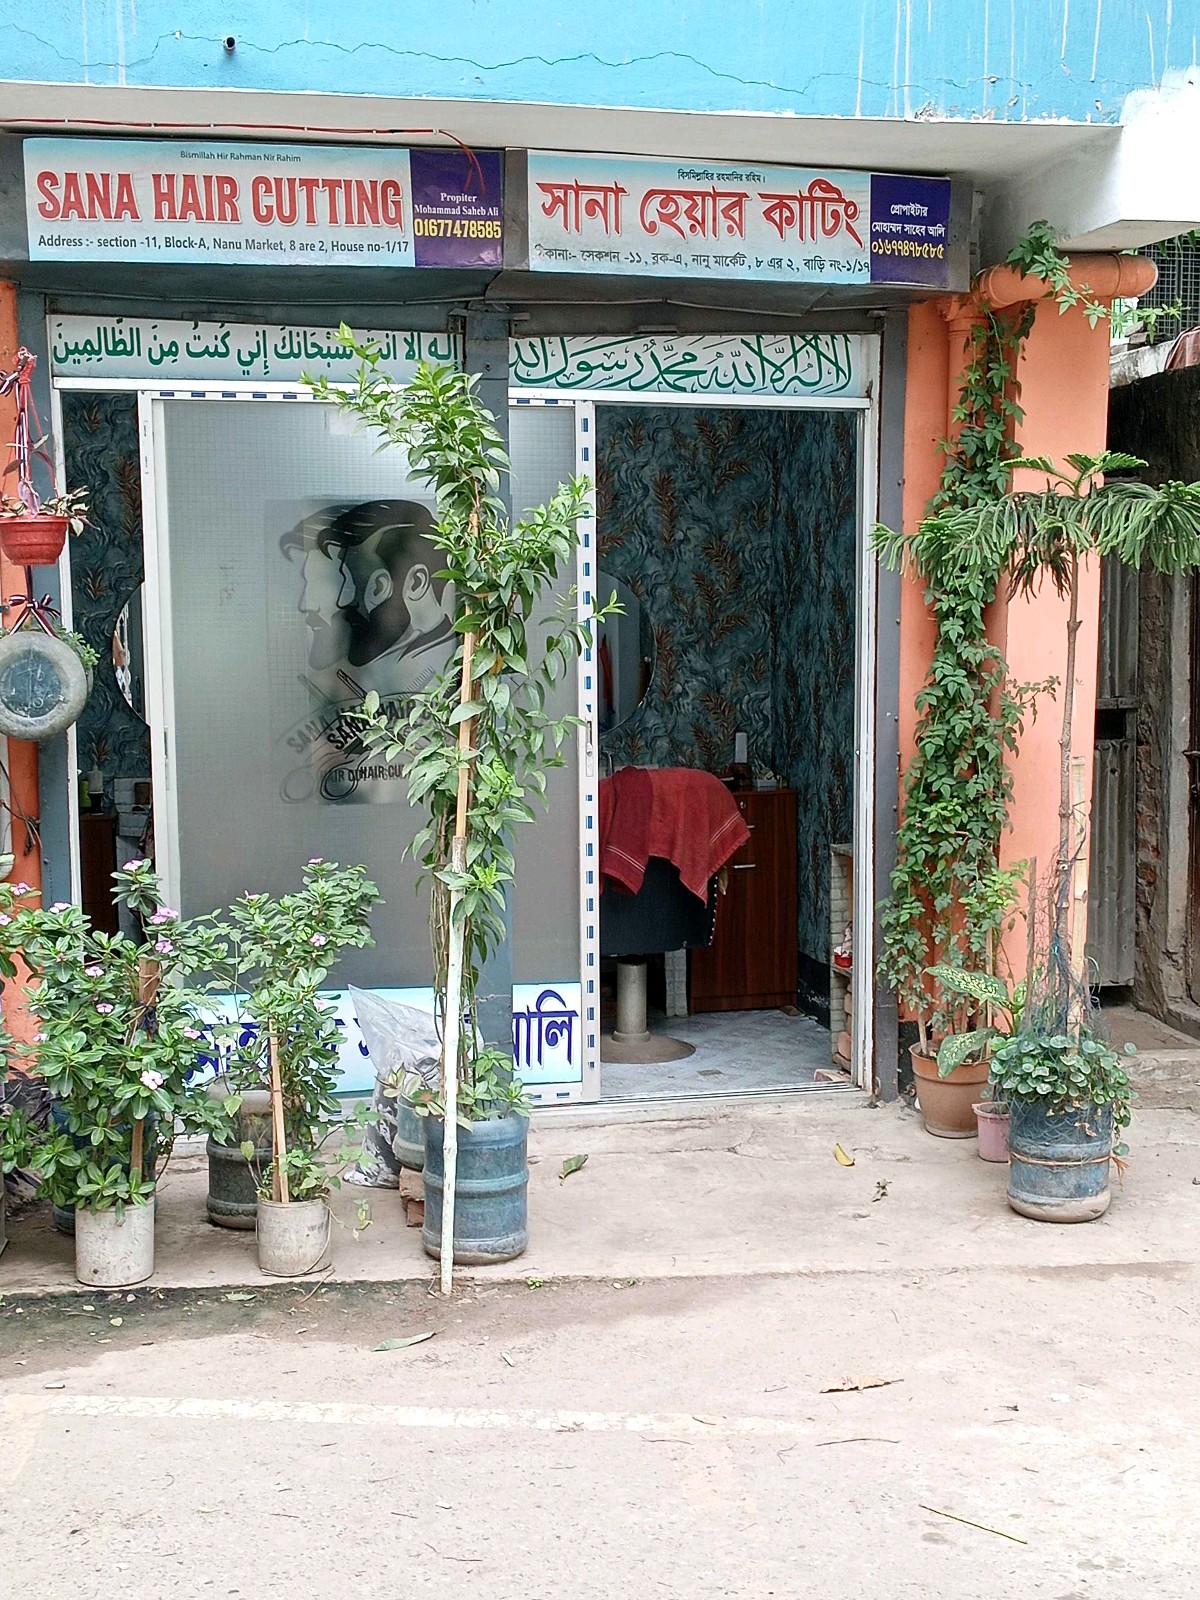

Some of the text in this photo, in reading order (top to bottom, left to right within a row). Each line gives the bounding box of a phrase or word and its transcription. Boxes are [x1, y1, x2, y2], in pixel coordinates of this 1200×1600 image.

[217, 152, 228, 160] Hir
[230, 152, 262, 161] Rahman
[263, 153, 275, 161] Nir
[276, 153, 301, 162] Rahim
[37, 170, 404, 236] SANA HAIR CUTTING
[440, 192, 477, 203] Propiter
[414, 204, 499, 216] Mohammad Saheb Ali
[535, 177, 865, 250] সানা হেয়ার কাটিং
[890, 202, 929, 217] প্রোপাইটার
[414, 218, 502, 239] 01677478585
[904, 224, 926, 236] সাহেব
[927, 223, 946, 238] আলি
[38, 235, 83, 247] Address
[97, 236, 137, 248] section
[164, 236, 210, 250] Block-A,
[213, 238, 242, 250] Nanu
[245, 239, 286, 252] Market,
[289, 240, 296, 251] 8
[299, 241, 316, 251] are
[331, 240, 364, 252] House
[367, 240, 409, 254] no-1/17
[871, 238, 945, 259] ০১৬৭৭৪৭৮৫৮৫
[580, 250, 620, 262] সেকশন
[691, 254, 711, 269] নানু
[755, 256, 764, 268] ৮
[767, 257, 783, 269] এর
[803, 255, 826, 273] বাড়ি
